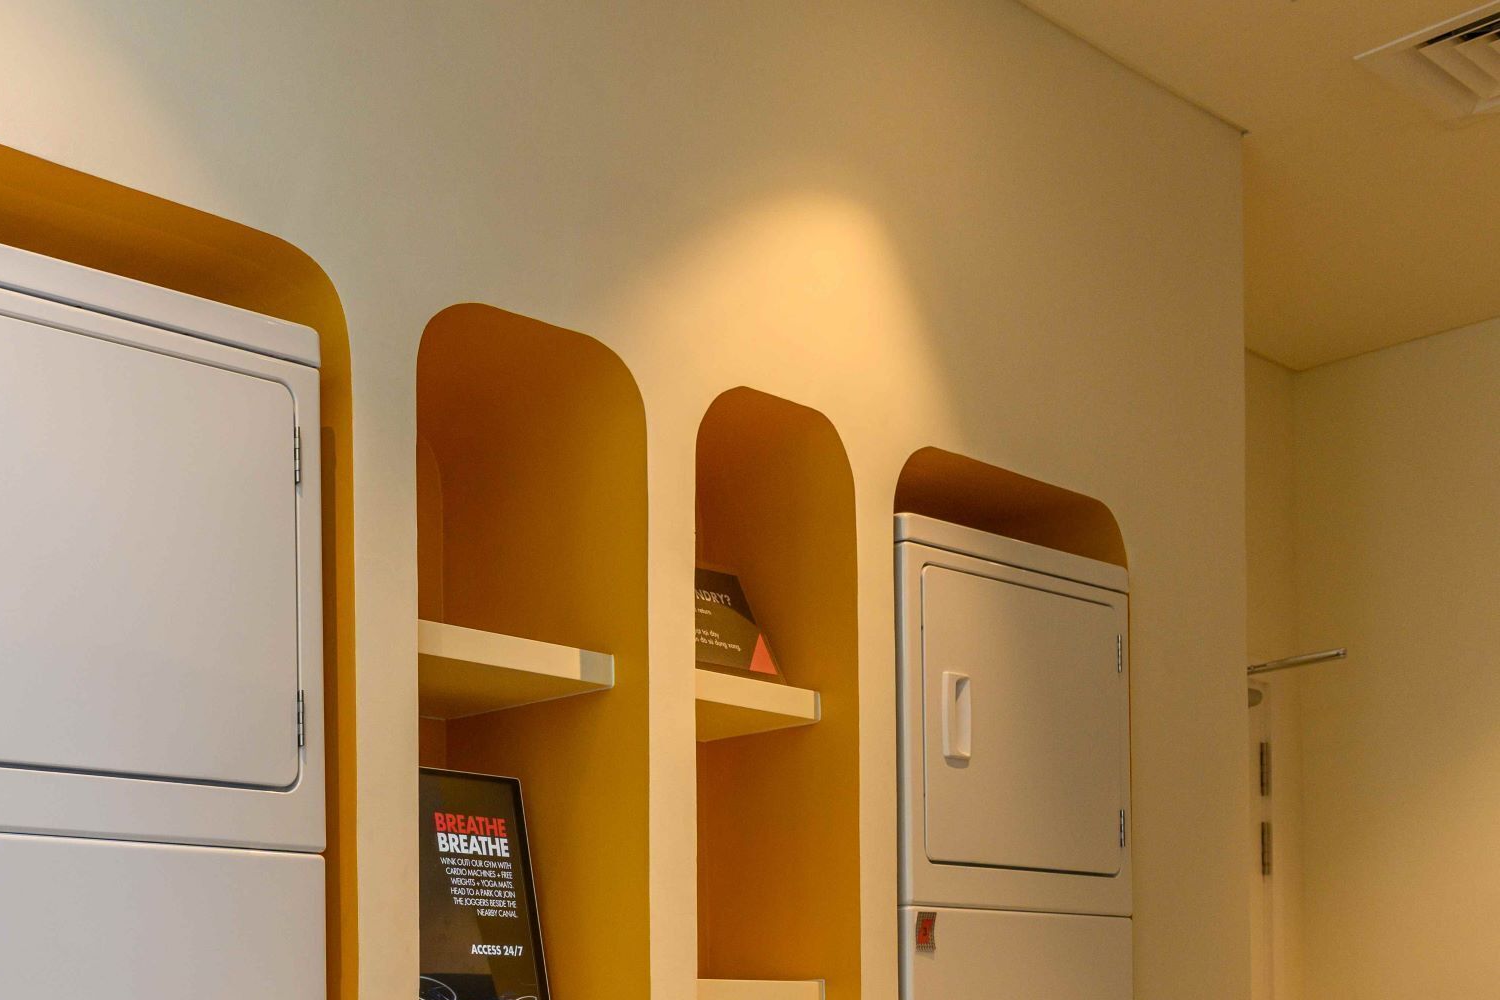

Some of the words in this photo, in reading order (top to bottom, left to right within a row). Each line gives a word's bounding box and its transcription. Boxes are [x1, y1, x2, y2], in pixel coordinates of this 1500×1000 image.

[434, 812, 507, 837] BREATHE
[437, 832, 510, 857] BREATHE
[484, 860, 497, 868] GYM
[498, 861, 511, 869] WITH
[445, 867, 467, 875] CARDIO
[468, 869, 496, 878] MACHINES
[501, 871, 513, 879] FREE
[451, 877, 475, 886] WEIGHTS
[450, 887, 466, 895] HEAD
[480, 889, 494, 897] PARK
[453, 897, 464, 905] THE
[464, 898, 489, 906] JOGGERS
[490, 899, 507, 907] BESIDE
[471, 944, 501, 955] ACCESS
[503, 945, 523, 956] 24/7
